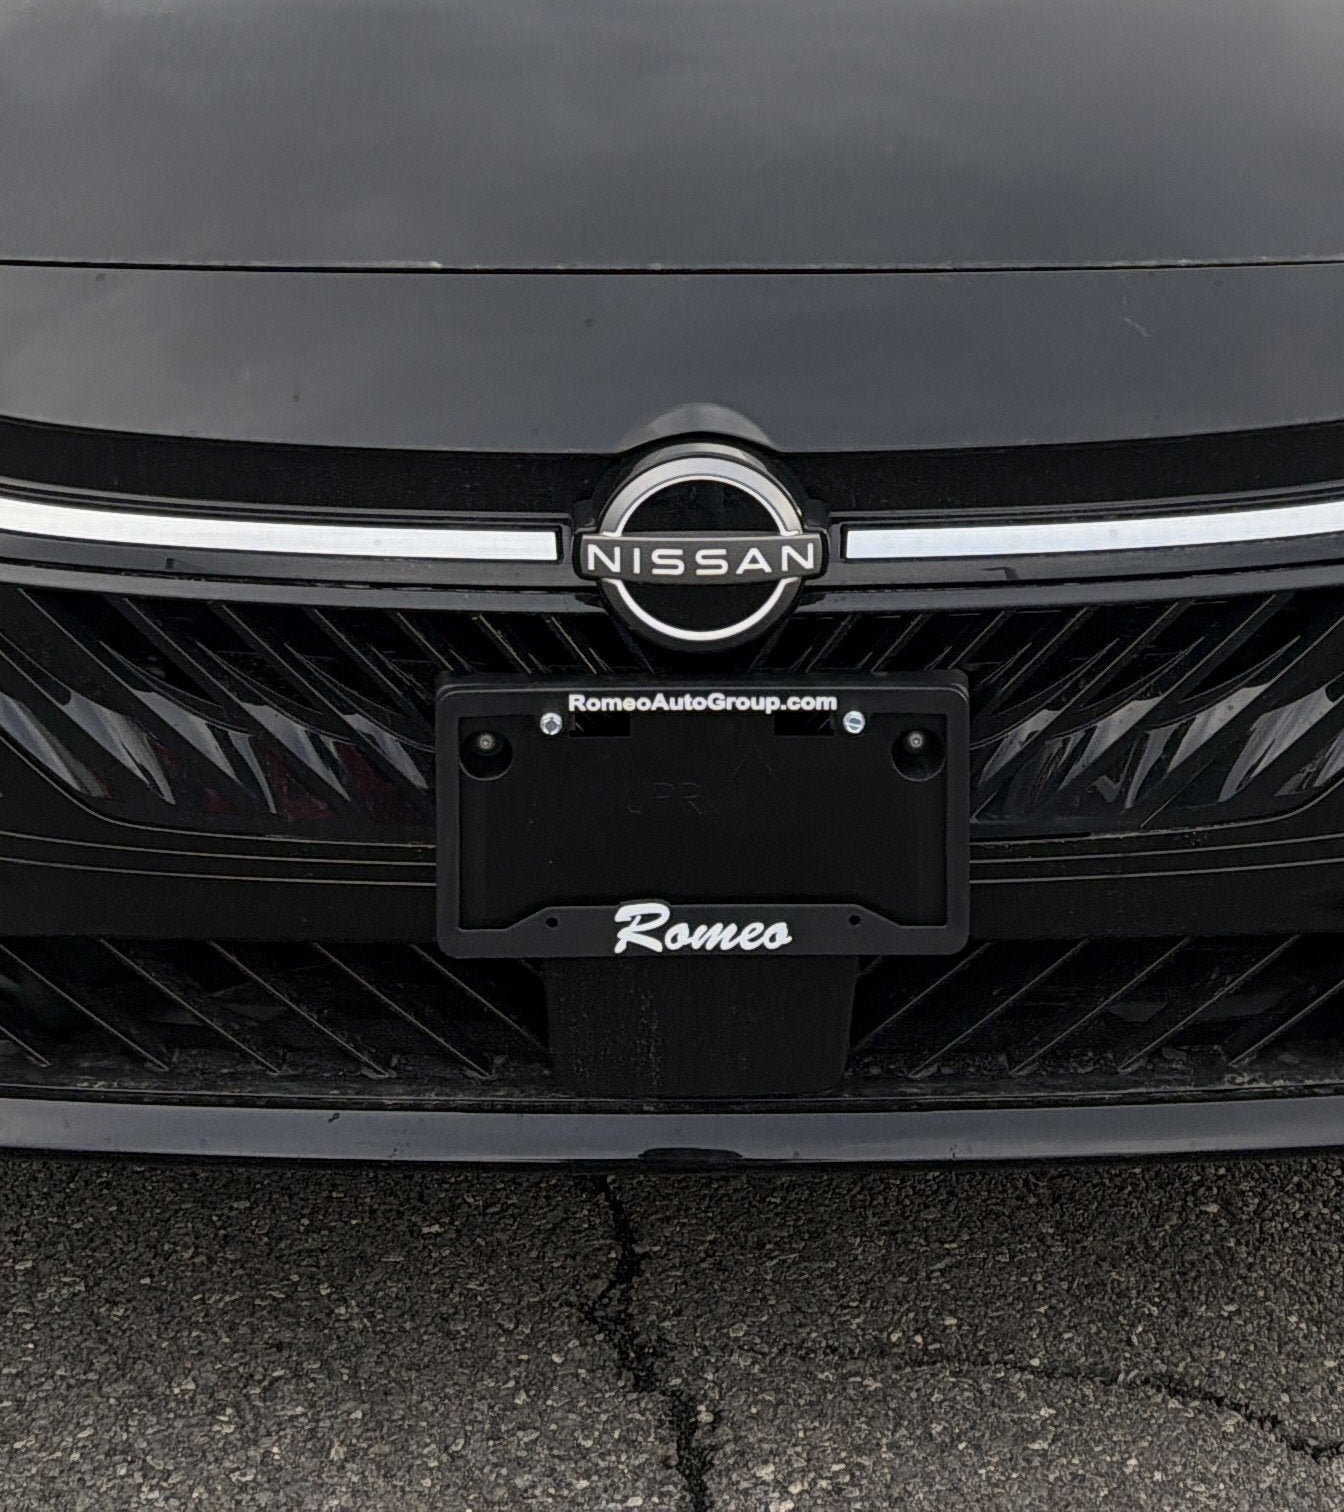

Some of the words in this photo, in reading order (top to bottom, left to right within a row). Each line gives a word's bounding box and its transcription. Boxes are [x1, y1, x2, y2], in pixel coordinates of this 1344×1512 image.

[587, 542, 815, 576] NISSAN
[568, 692, 837, 714] RomeoAutoGroup.com
[614, 902, 793, 954] Romeo
